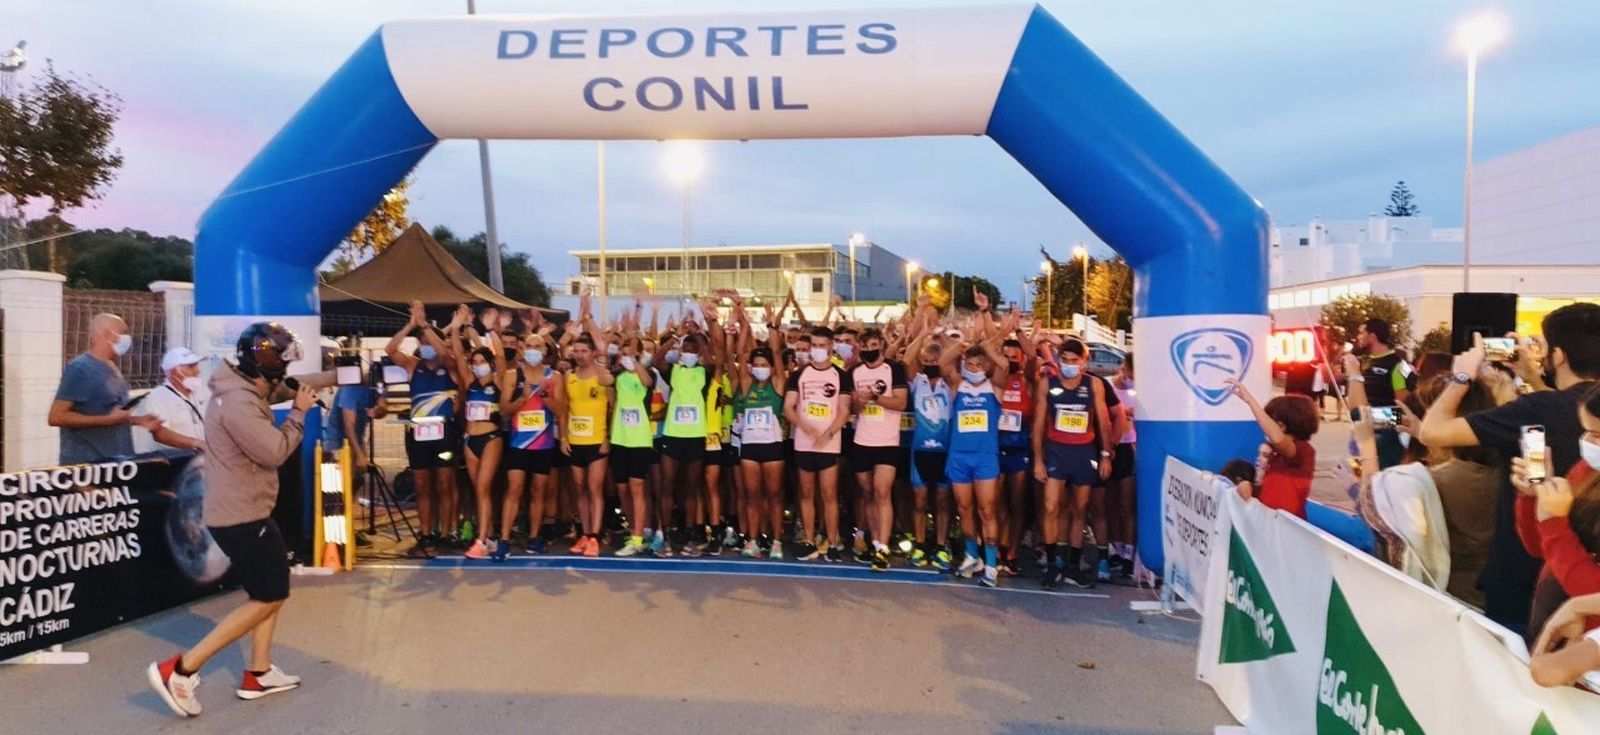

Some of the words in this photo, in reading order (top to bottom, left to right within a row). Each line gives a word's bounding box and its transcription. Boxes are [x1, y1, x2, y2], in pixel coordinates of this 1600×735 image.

[496, 22, 899, 60] DEPORTES
[582, 75, 810, 112] CONIL
[809, 406, 825, 415] 211
[964, 416, 982, 425] 234
[0, 461, 138, 496] CIRCUITO
[0, 486, 139, 525] PROVINCIAL
[0, 527, 33, 553] DE
[34, 508, 141, 545] CARRERAS
[0, 532, 142, 588] NOCTURNAS
[0, 582, 75, 627] CÁDIZ
[0, 630, 26, 647] 5km
[27, 624, 35, 639] /
[36, 618, 70, 636] 15km
